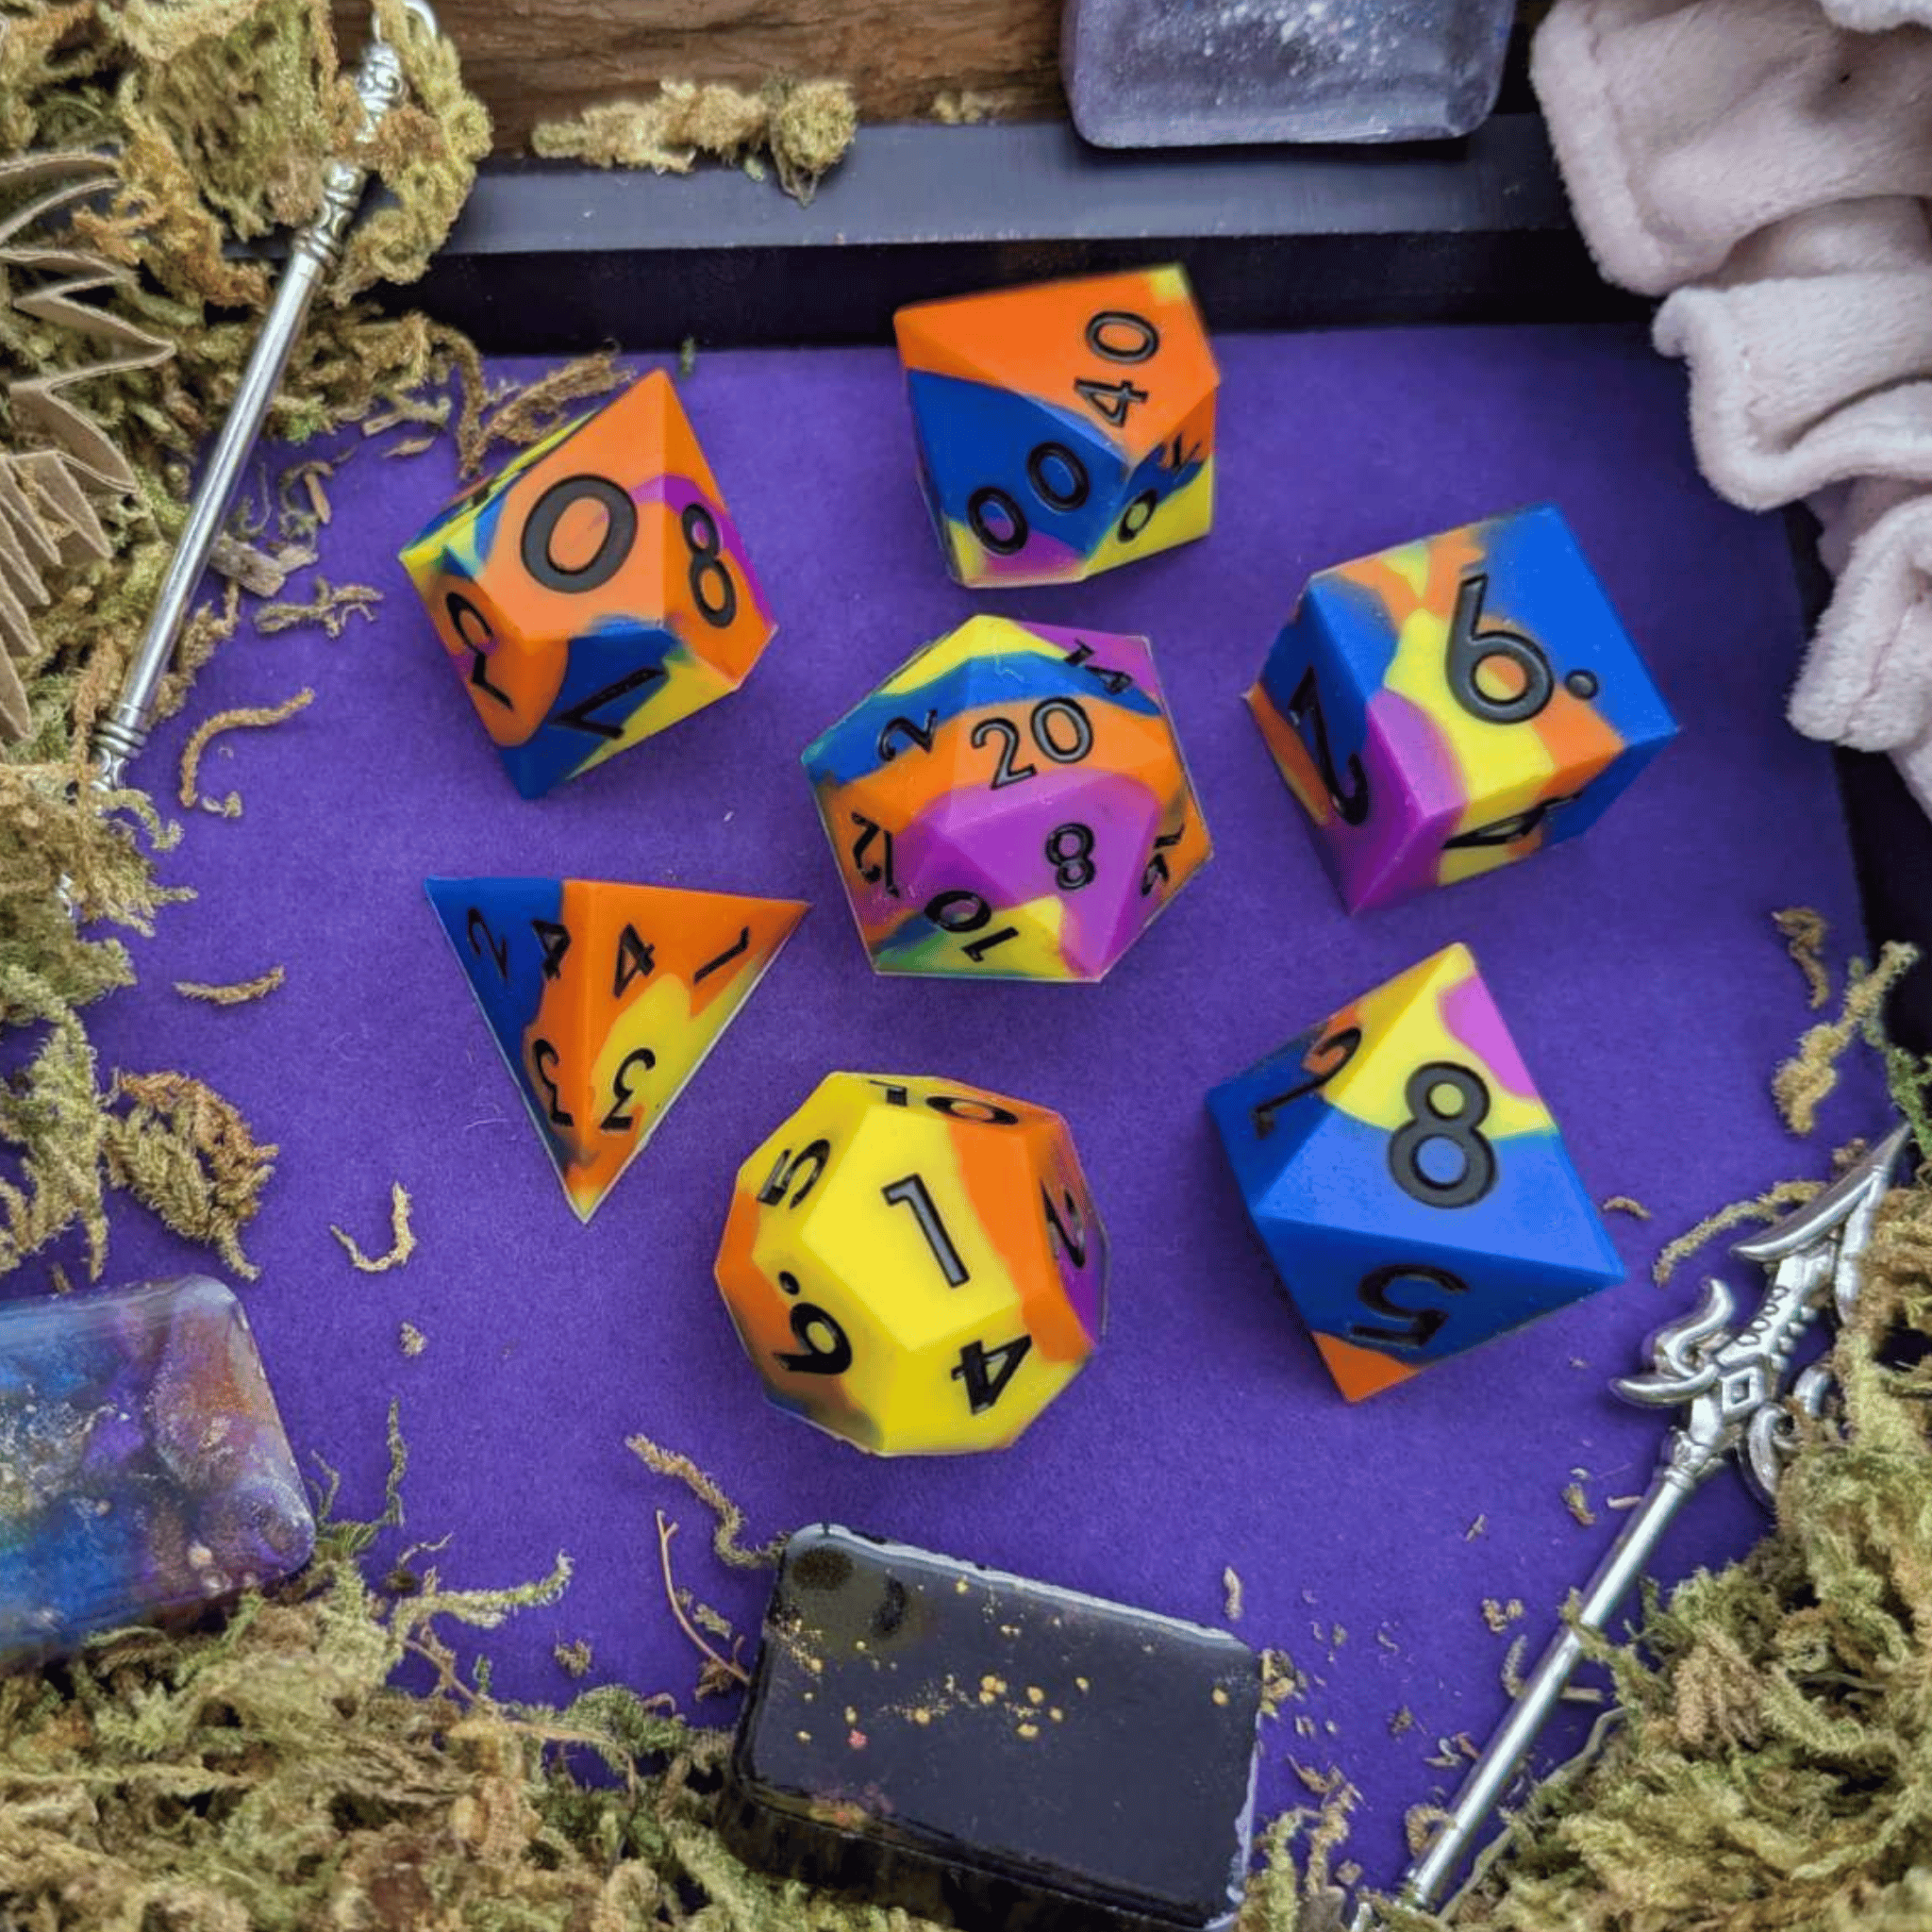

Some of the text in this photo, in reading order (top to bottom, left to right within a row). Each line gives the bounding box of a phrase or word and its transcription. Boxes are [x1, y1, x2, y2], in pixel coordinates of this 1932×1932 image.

[1074, 309, 1160, 428] 40
[520, 473, 640, 594] 0
[966, 441, 1091, 557] 00
[681, 502, 738, 629] 8
[1064, 637, 1134, 696] 14
[876, 708, 939, 762] 2
[970, 695, 1094, 791] 20
[1288, 666, 1370, 826] 2
[1044, 823, 1097, 891] 8
[467, 907, 509, 980] 2
[531, 918, 573, 981] 4
[613, 923, 656, 998] 4
[694, 924, 750, 986] 1
[924, 890, 1019, 963] 10
[532, 1038, 575, 1128] 3
[600, 1047, 657, 1132] 3
[757, 1138, 831, 1210] 5
[1387, 1059, 1498, 1208] 8
[881, 1173, 971, 1289] 1
[1350, 1262, 1471, 1350] 5
[951, 1334, 1033, 1416] 4
